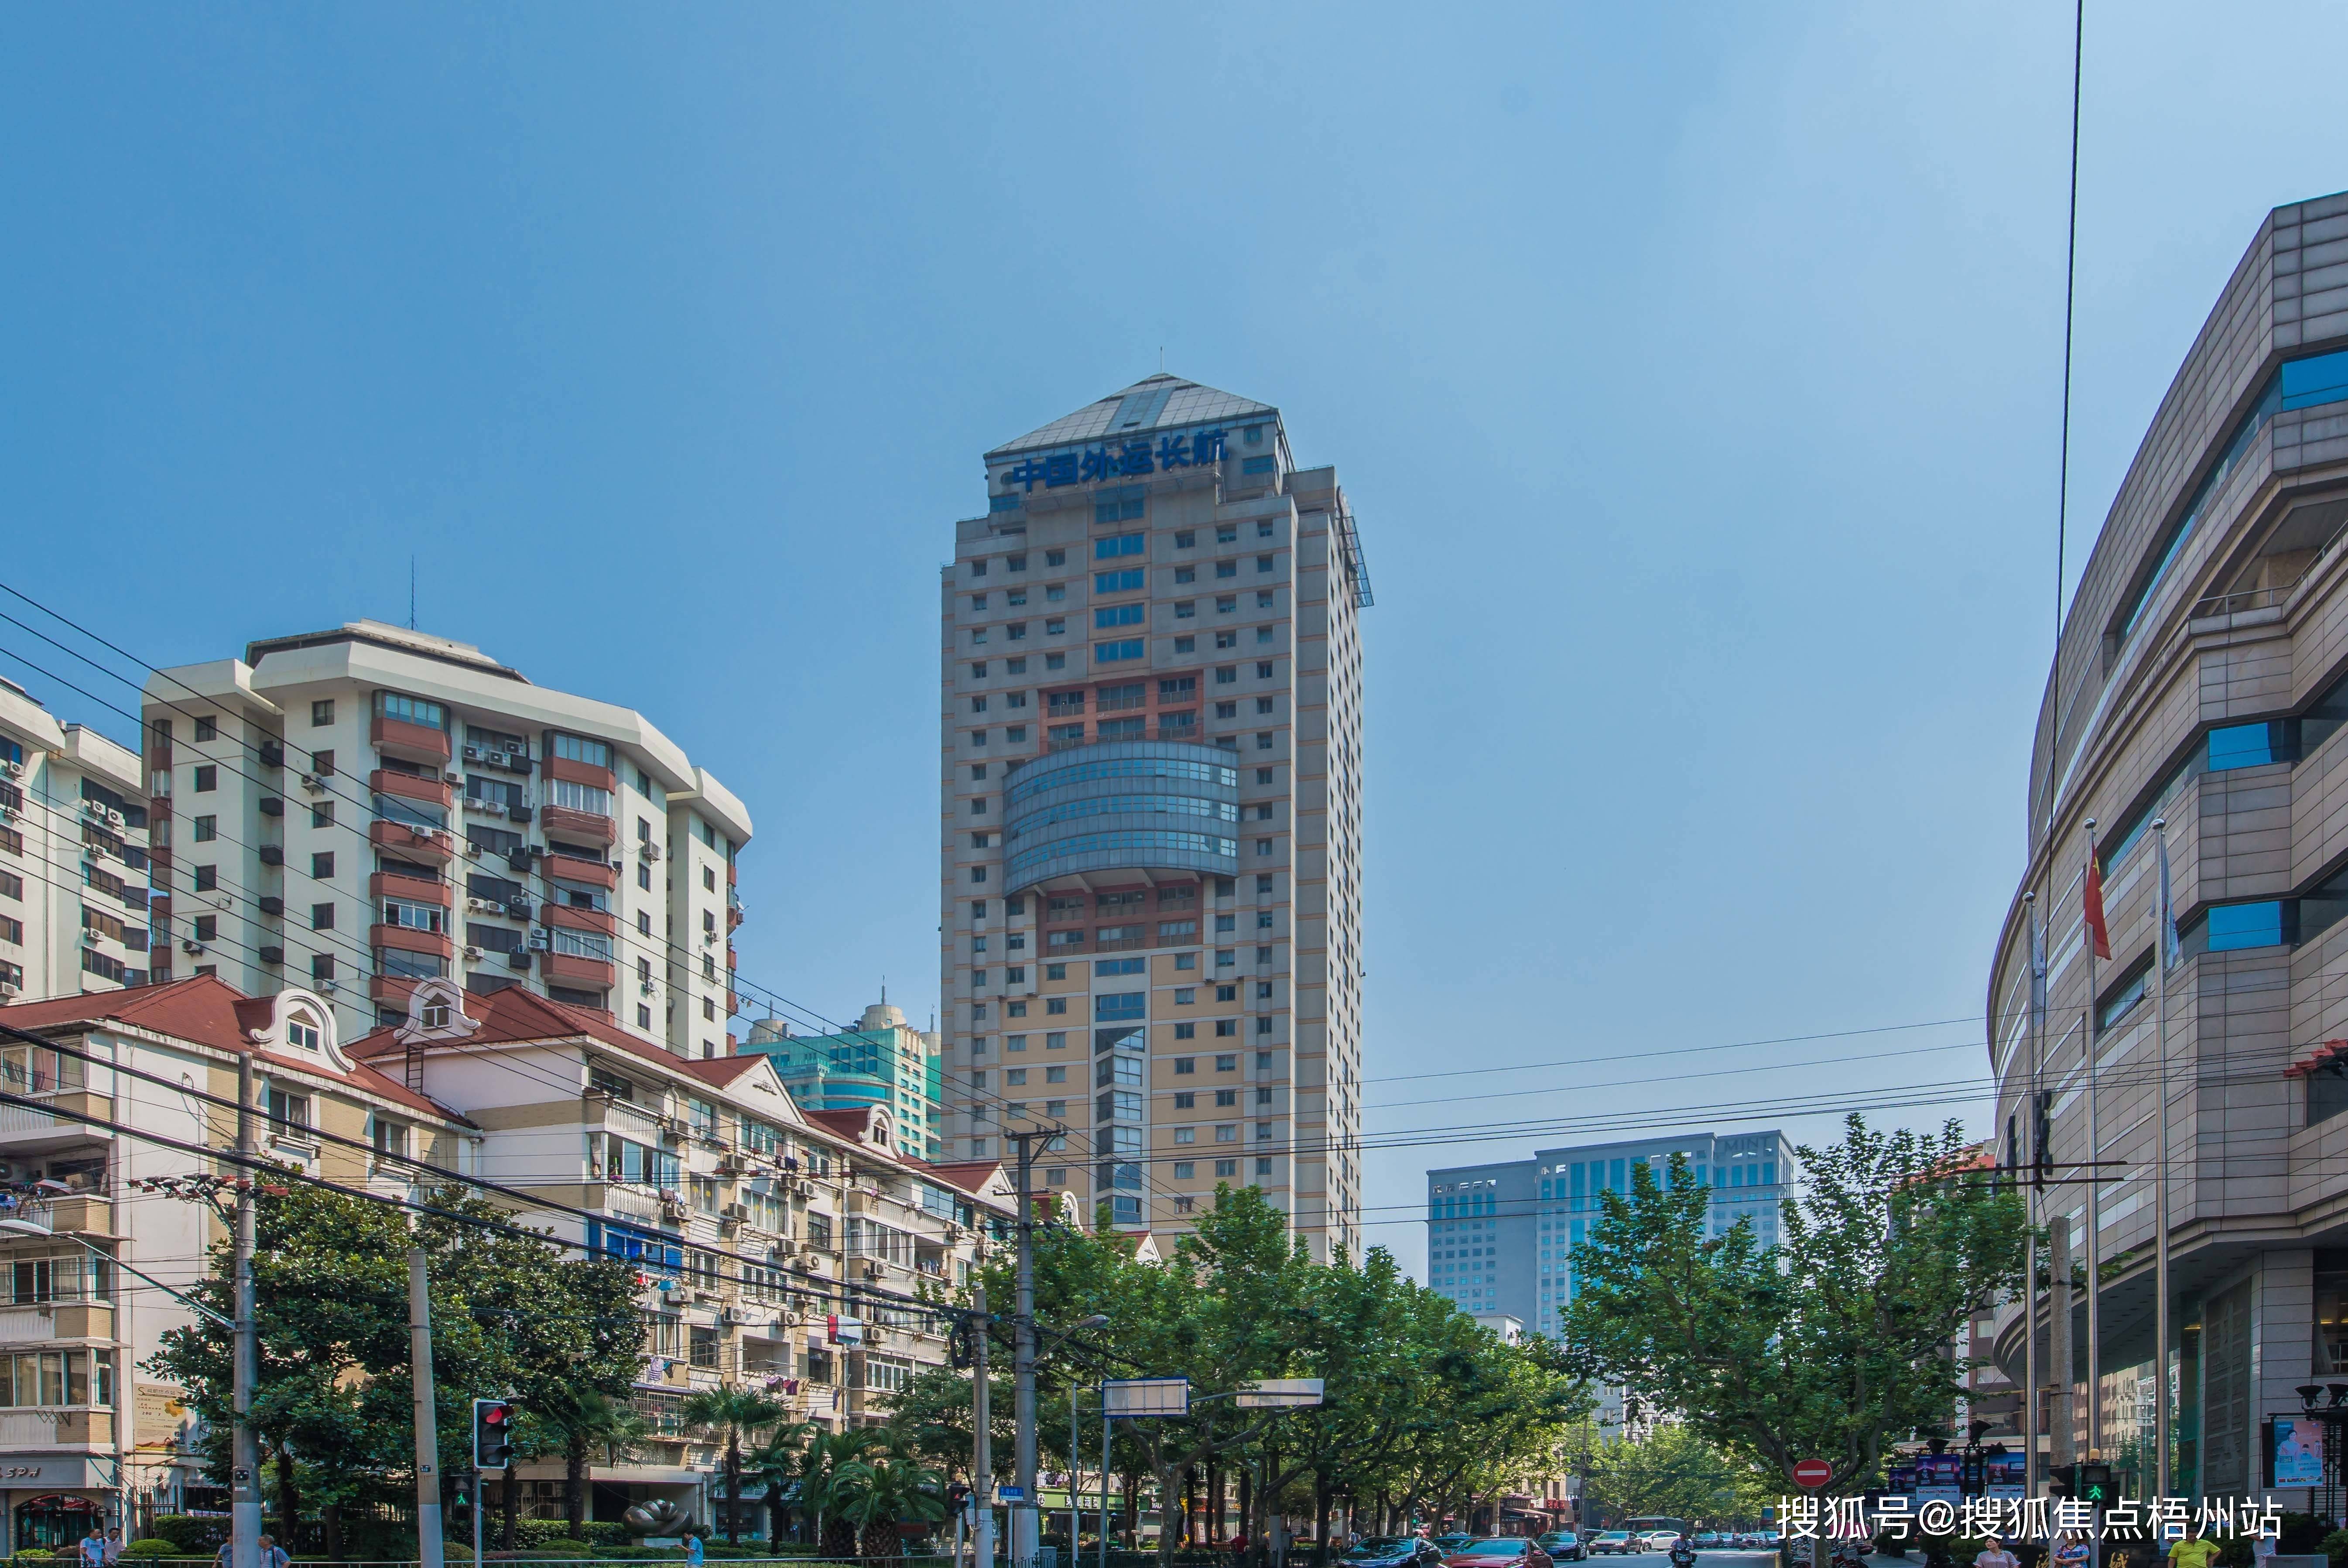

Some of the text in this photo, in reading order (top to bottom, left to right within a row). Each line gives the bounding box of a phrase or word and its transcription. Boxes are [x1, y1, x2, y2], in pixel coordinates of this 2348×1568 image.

[1013, 428, 1229, 493] 中国外运长航
[1724, 1136, 1771, 1151] MINT
